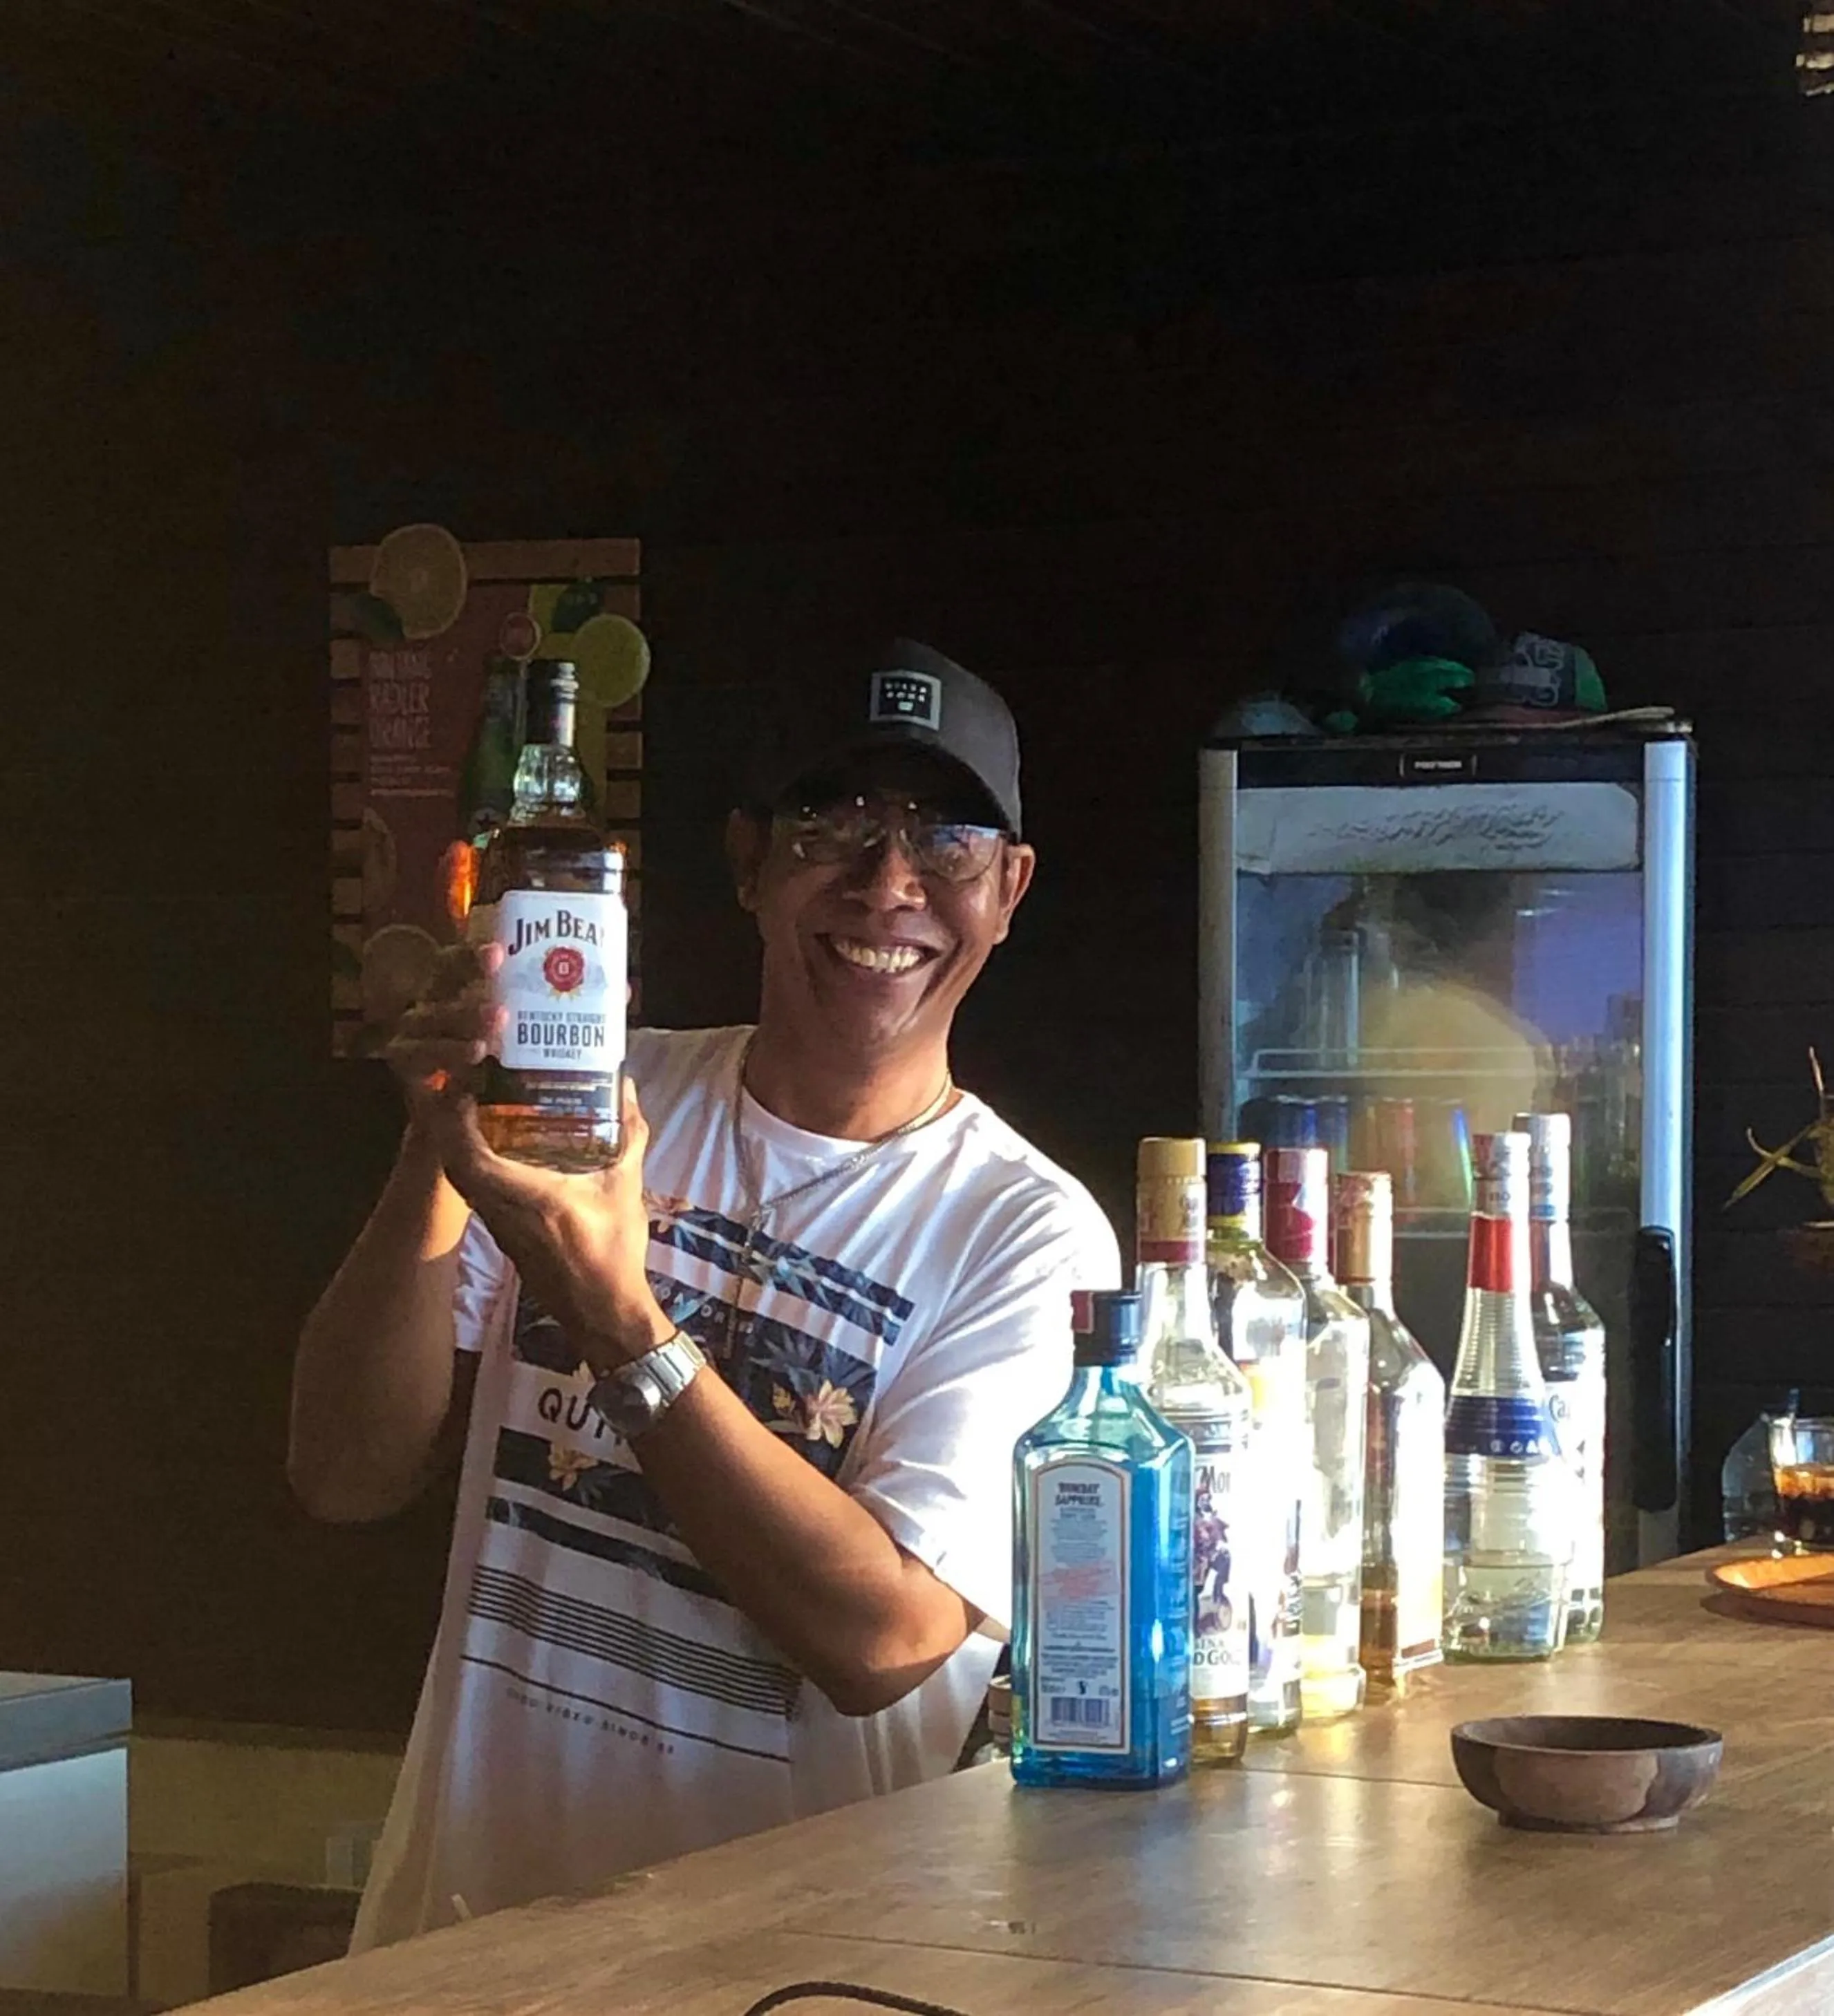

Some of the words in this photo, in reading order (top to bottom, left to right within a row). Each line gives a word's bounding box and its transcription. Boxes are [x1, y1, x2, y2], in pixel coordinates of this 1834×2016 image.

[507, 917, 551, 955] JIM
[556, 909, 604, 946] BEA
[517, 1022, 605, 1048] BOURBON
